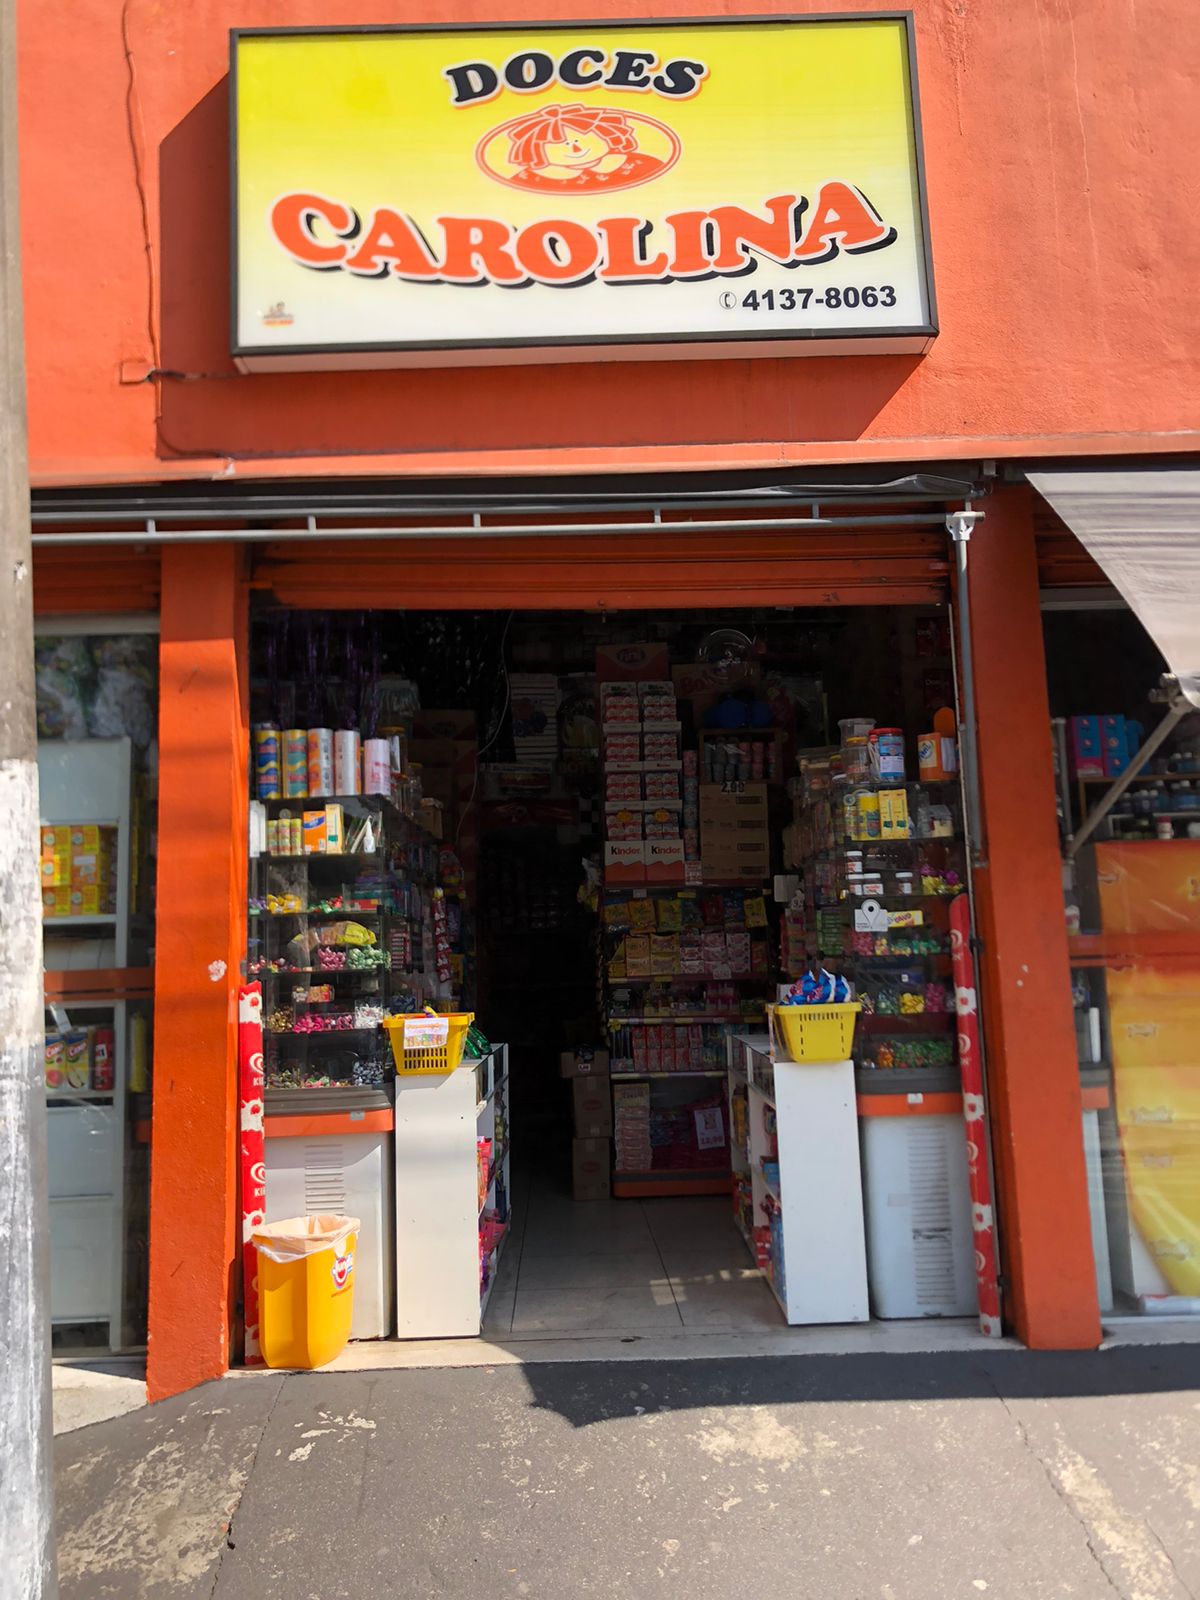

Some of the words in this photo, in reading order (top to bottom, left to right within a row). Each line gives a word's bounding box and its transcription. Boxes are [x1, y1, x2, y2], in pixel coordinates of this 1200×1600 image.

[446, 50, 706, 103] DOCES
[271, 182, 896, 287] CAROLINA
[741, 286, 897, 311] 4137-8063
[611, 846, 640, 855] Kinder
[651, 846, 681, 855] Kinder
